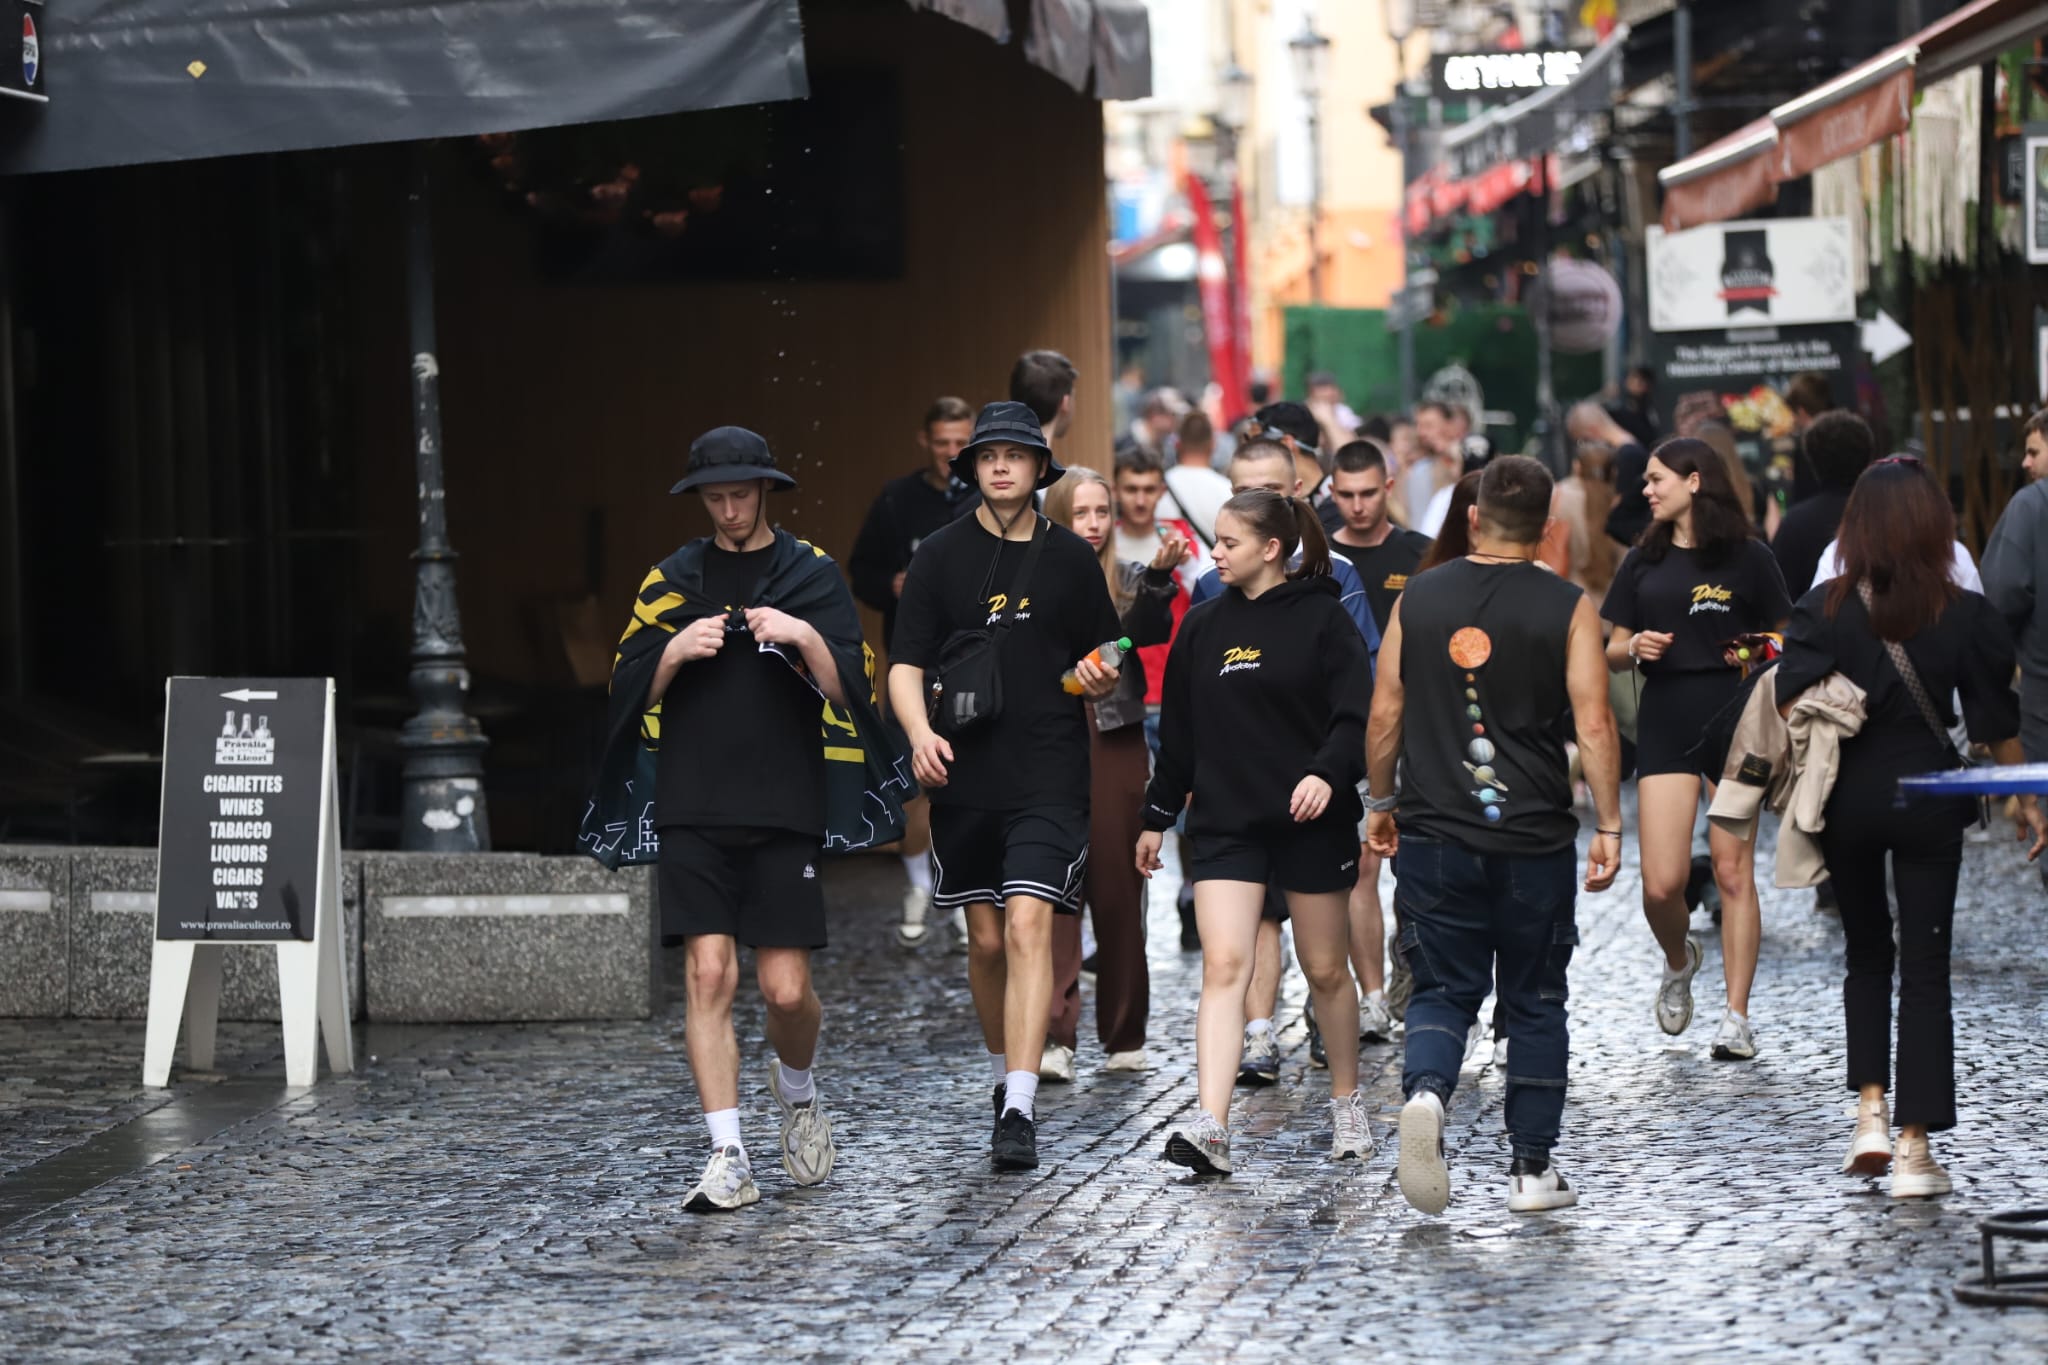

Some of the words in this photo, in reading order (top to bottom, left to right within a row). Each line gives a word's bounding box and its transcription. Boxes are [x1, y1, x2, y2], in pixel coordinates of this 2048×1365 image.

[203, 774, 283, 793] CIGARETTES
[219, 798, 264, 816] WINES
[209, 821, 272, 839] TABACCO
[210, 845, 267, 863] LIQUORS
[212, 868, 263, 886] CIGARS
[180, 920, 292, 931] www.pravaliaculicori.ro
